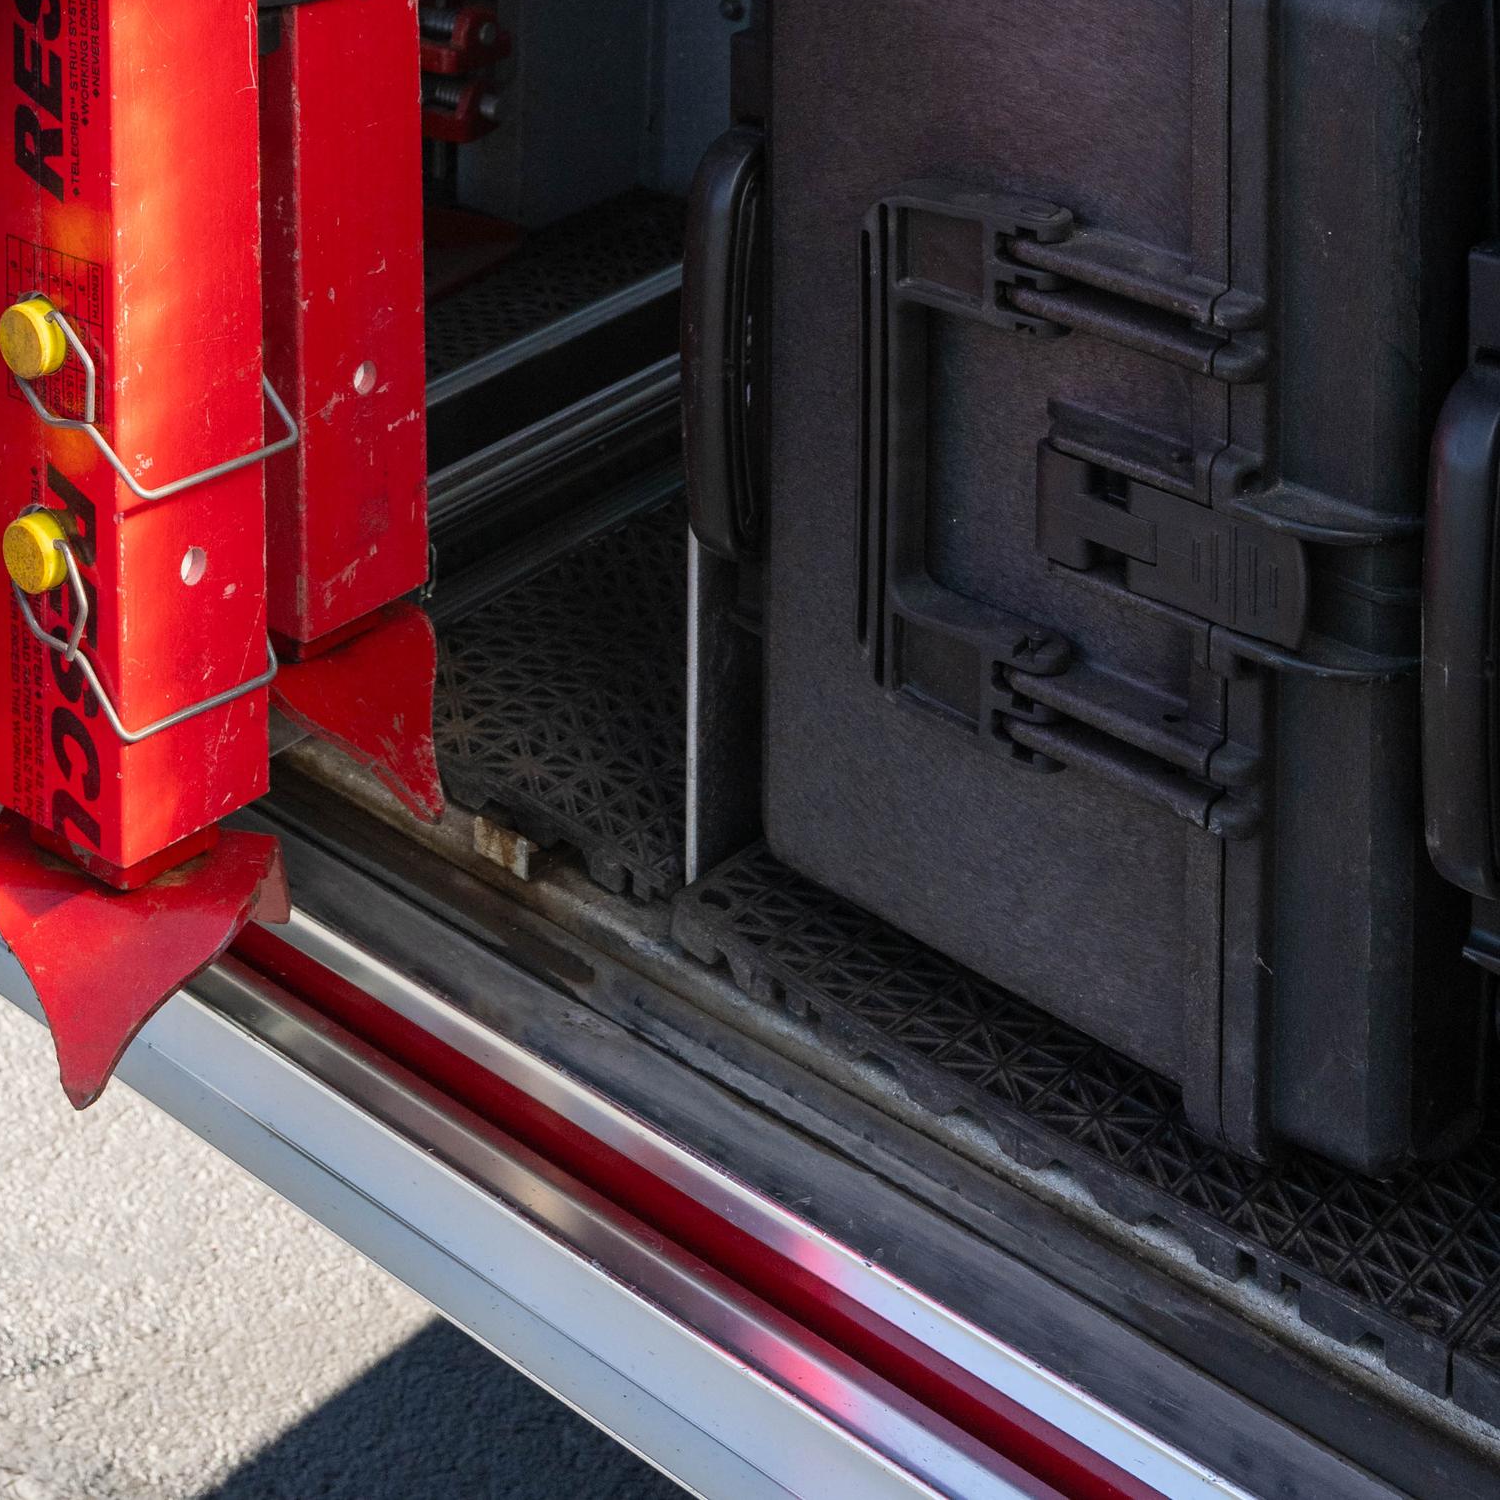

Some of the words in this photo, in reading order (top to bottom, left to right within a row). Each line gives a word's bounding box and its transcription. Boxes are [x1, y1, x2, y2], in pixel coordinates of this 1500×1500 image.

[69, 40, 78, 91] STRUT
[80, 41, 89, 115] WORKING
[91, 36, 100, 87] NEVER
[11, 687, 21, 715] THE
[13, 719, 21, 793] WORKING
